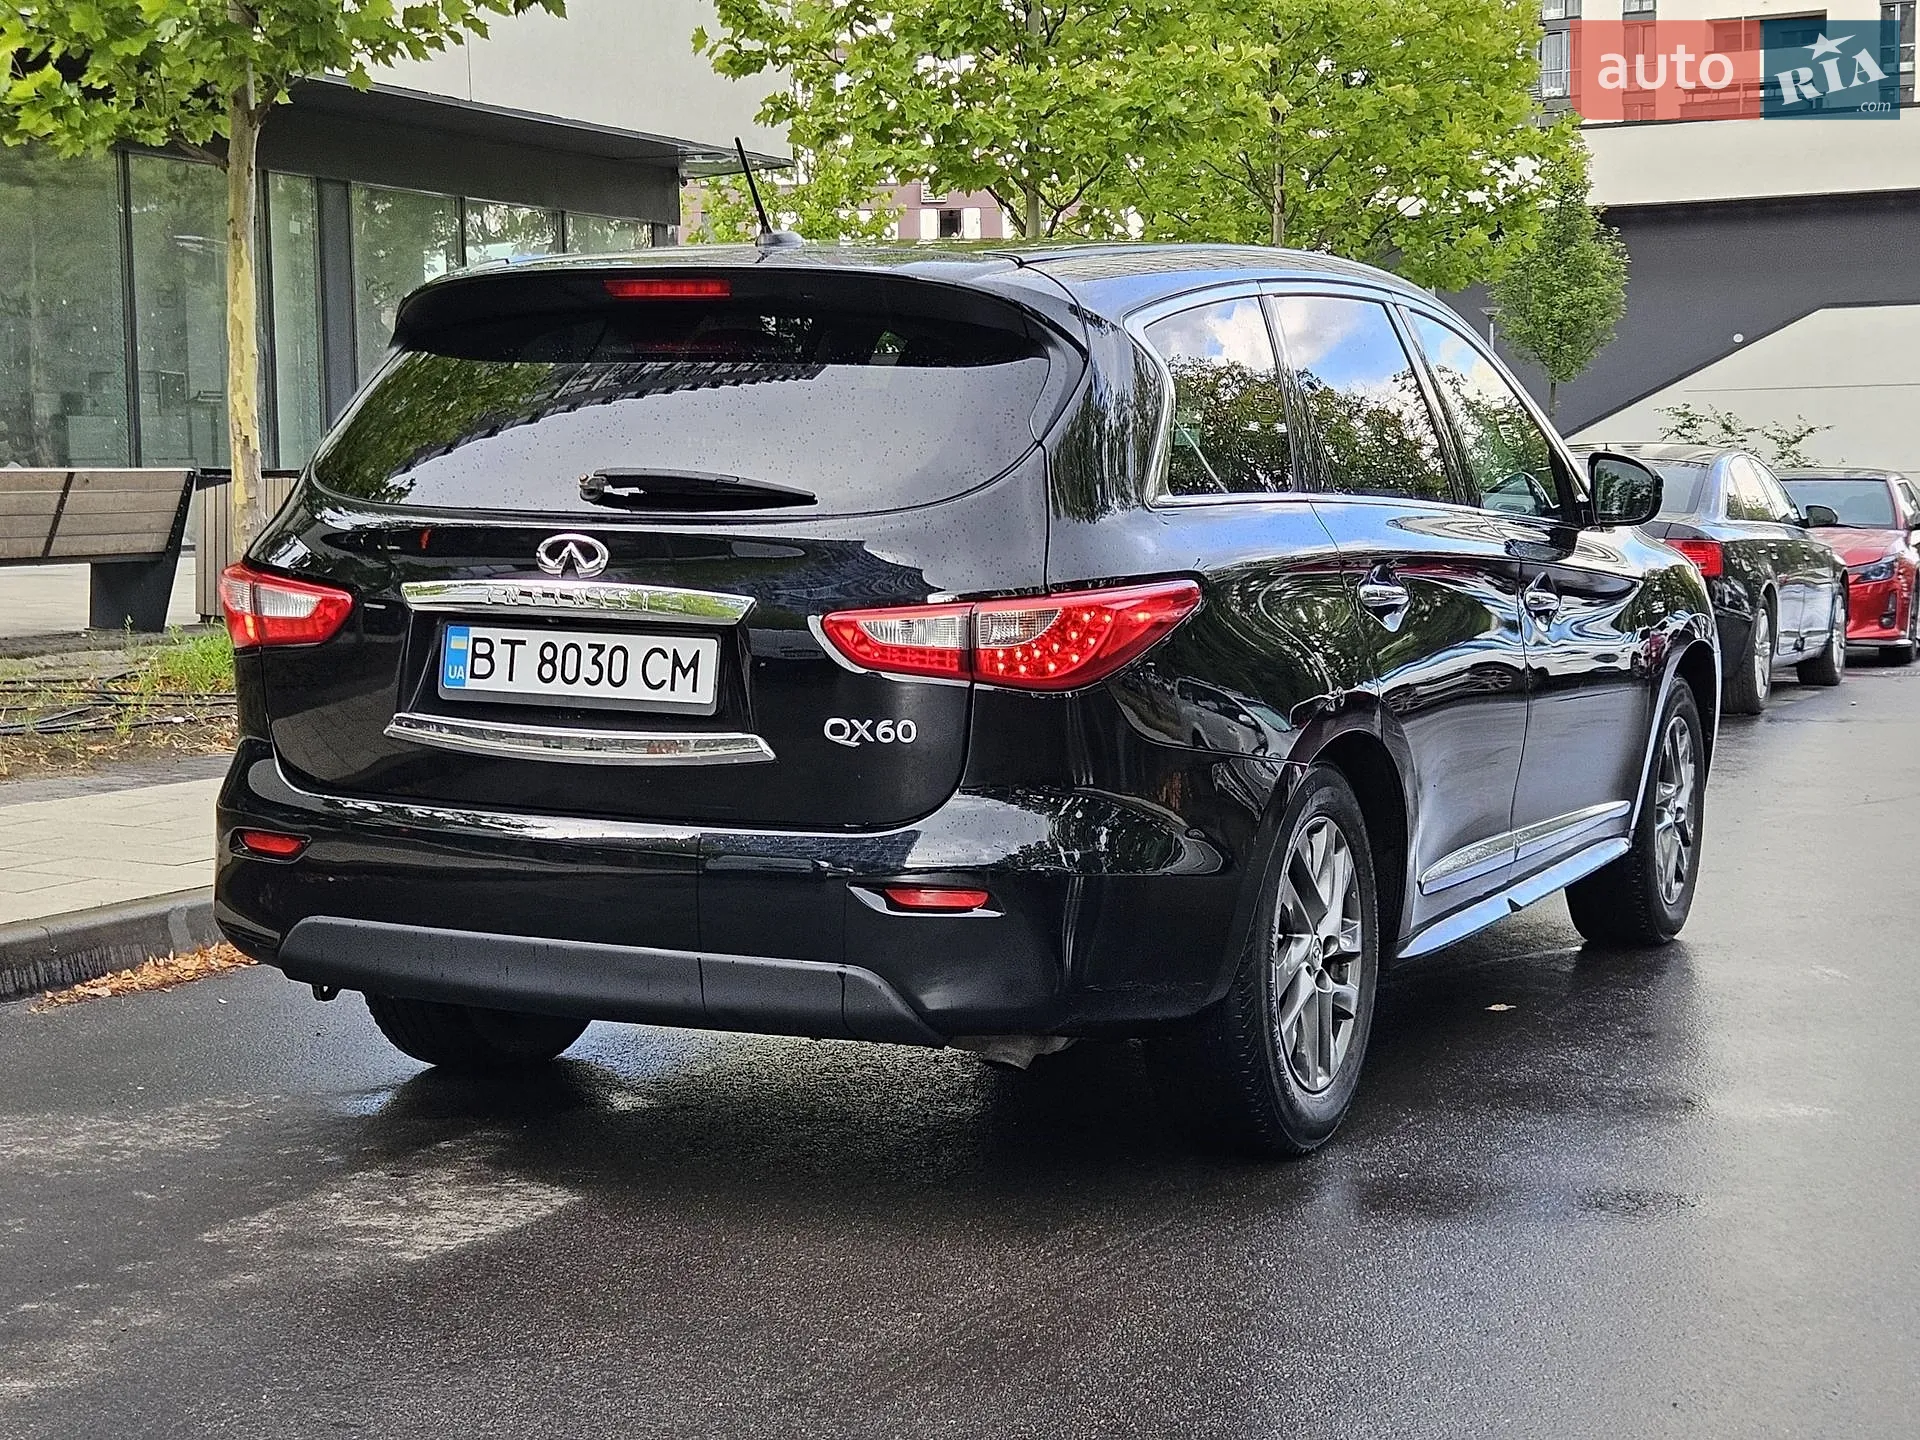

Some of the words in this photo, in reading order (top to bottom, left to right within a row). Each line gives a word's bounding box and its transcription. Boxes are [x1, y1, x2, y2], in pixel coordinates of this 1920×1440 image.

[448, 665, 465, 680] UA
[469, 636, 527, 682] BT
[537, 641, 629, 688] 8030
[641, 647, 701, 693] CM
[823, 717, 917, 748] QX60
